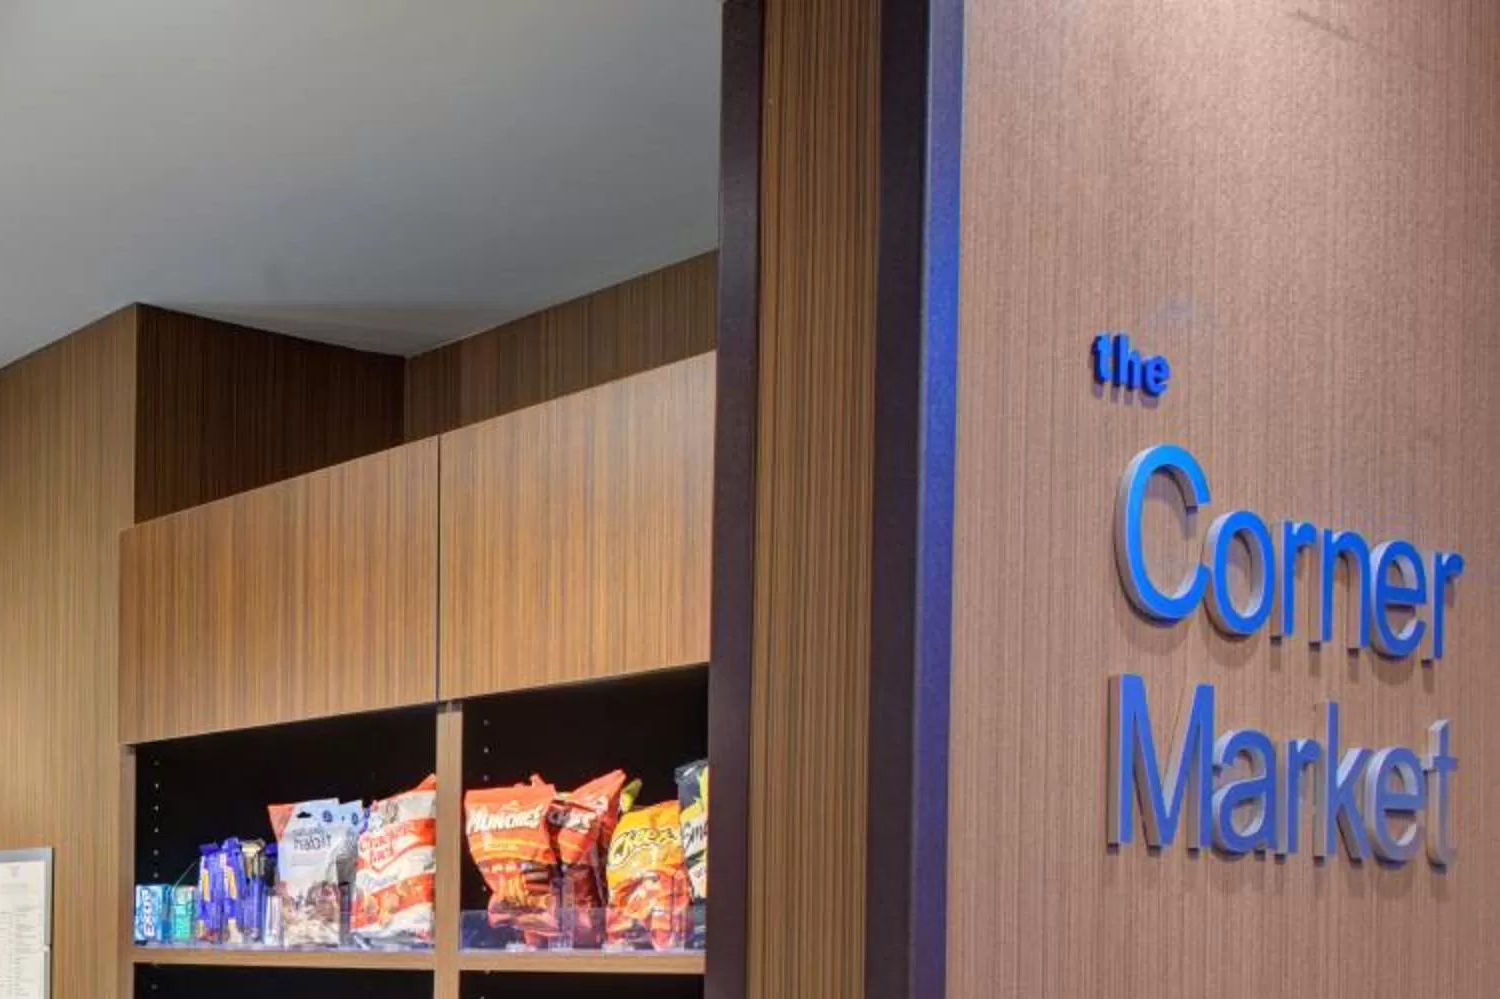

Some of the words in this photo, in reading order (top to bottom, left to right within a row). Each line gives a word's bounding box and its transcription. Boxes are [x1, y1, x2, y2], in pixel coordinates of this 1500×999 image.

[1092, 331, 1170, 397] the
[1116, 442, 1465, 665] Corner
[466, 804, 545, 835] MUNCHIES
[1107, 672, 1458, 868] Market
